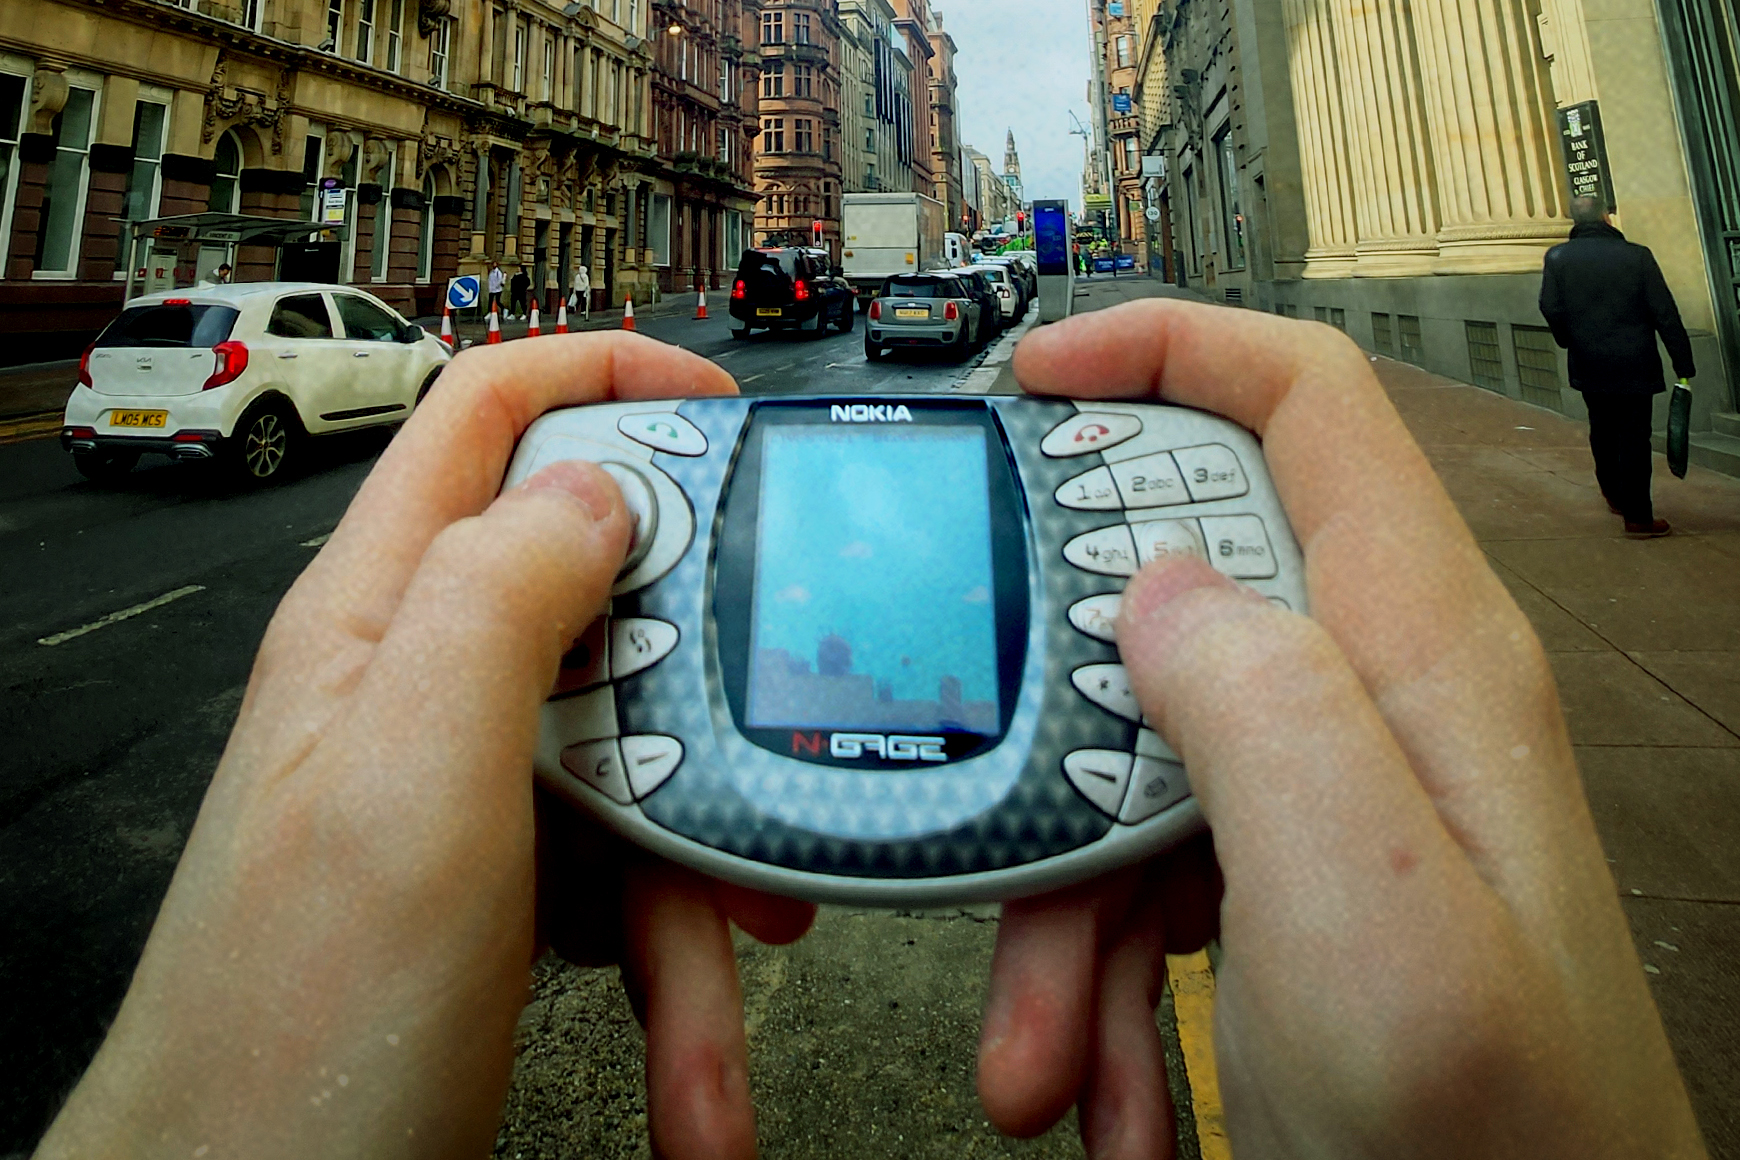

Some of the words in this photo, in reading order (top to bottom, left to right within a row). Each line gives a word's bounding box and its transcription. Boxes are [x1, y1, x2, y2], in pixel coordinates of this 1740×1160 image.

[1570, 140, 1588, 151] BANK
[1576, 150, 1586, 161] OF
[1568, 159, 1598, 173] SCOTLAND
[1574, 174, 1598, 186] GLASGOW
[831, 405, 913, 422] NOKIA
[141, 414, 162, 426] MCS
